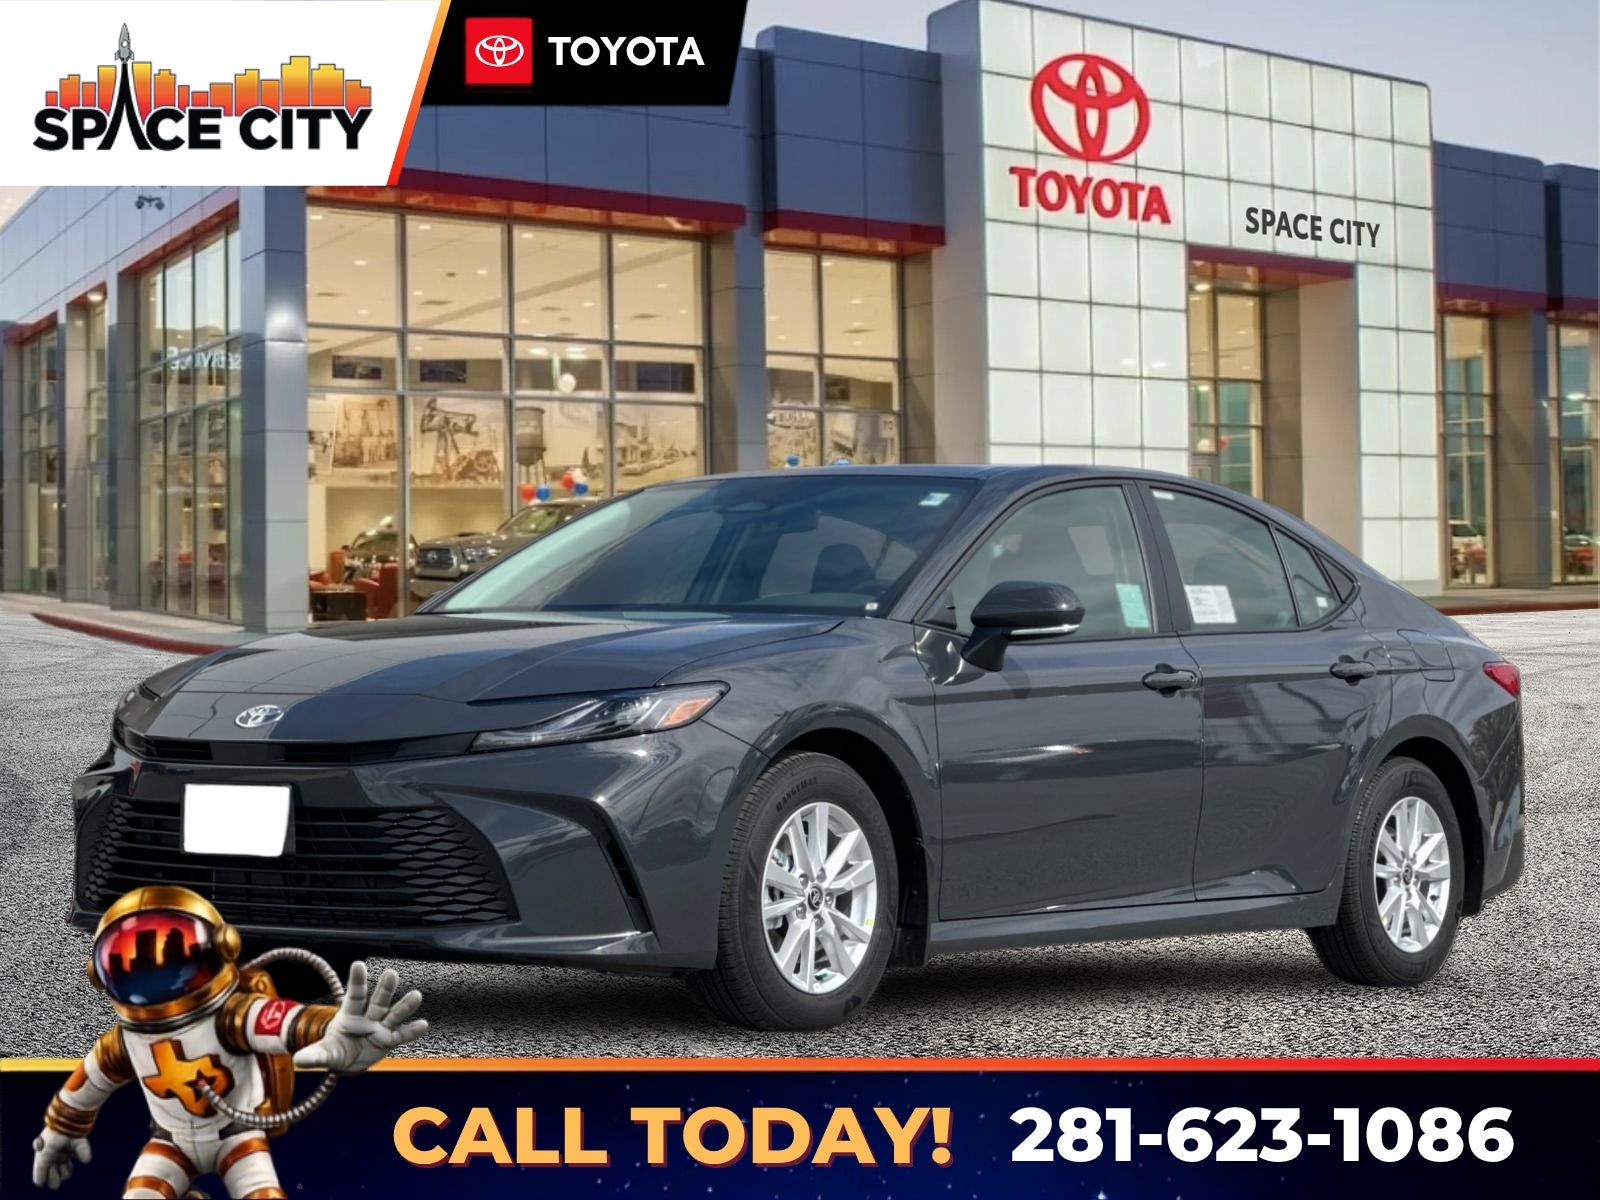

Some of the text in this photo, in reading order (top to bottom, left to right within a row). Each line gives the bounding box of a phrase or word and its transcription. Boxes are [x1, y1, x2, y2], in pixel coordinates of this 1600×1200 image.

[1009, 166, 1171, 224] TOYOTA
[1245, 206, 1380, 248] SPACE CITY
